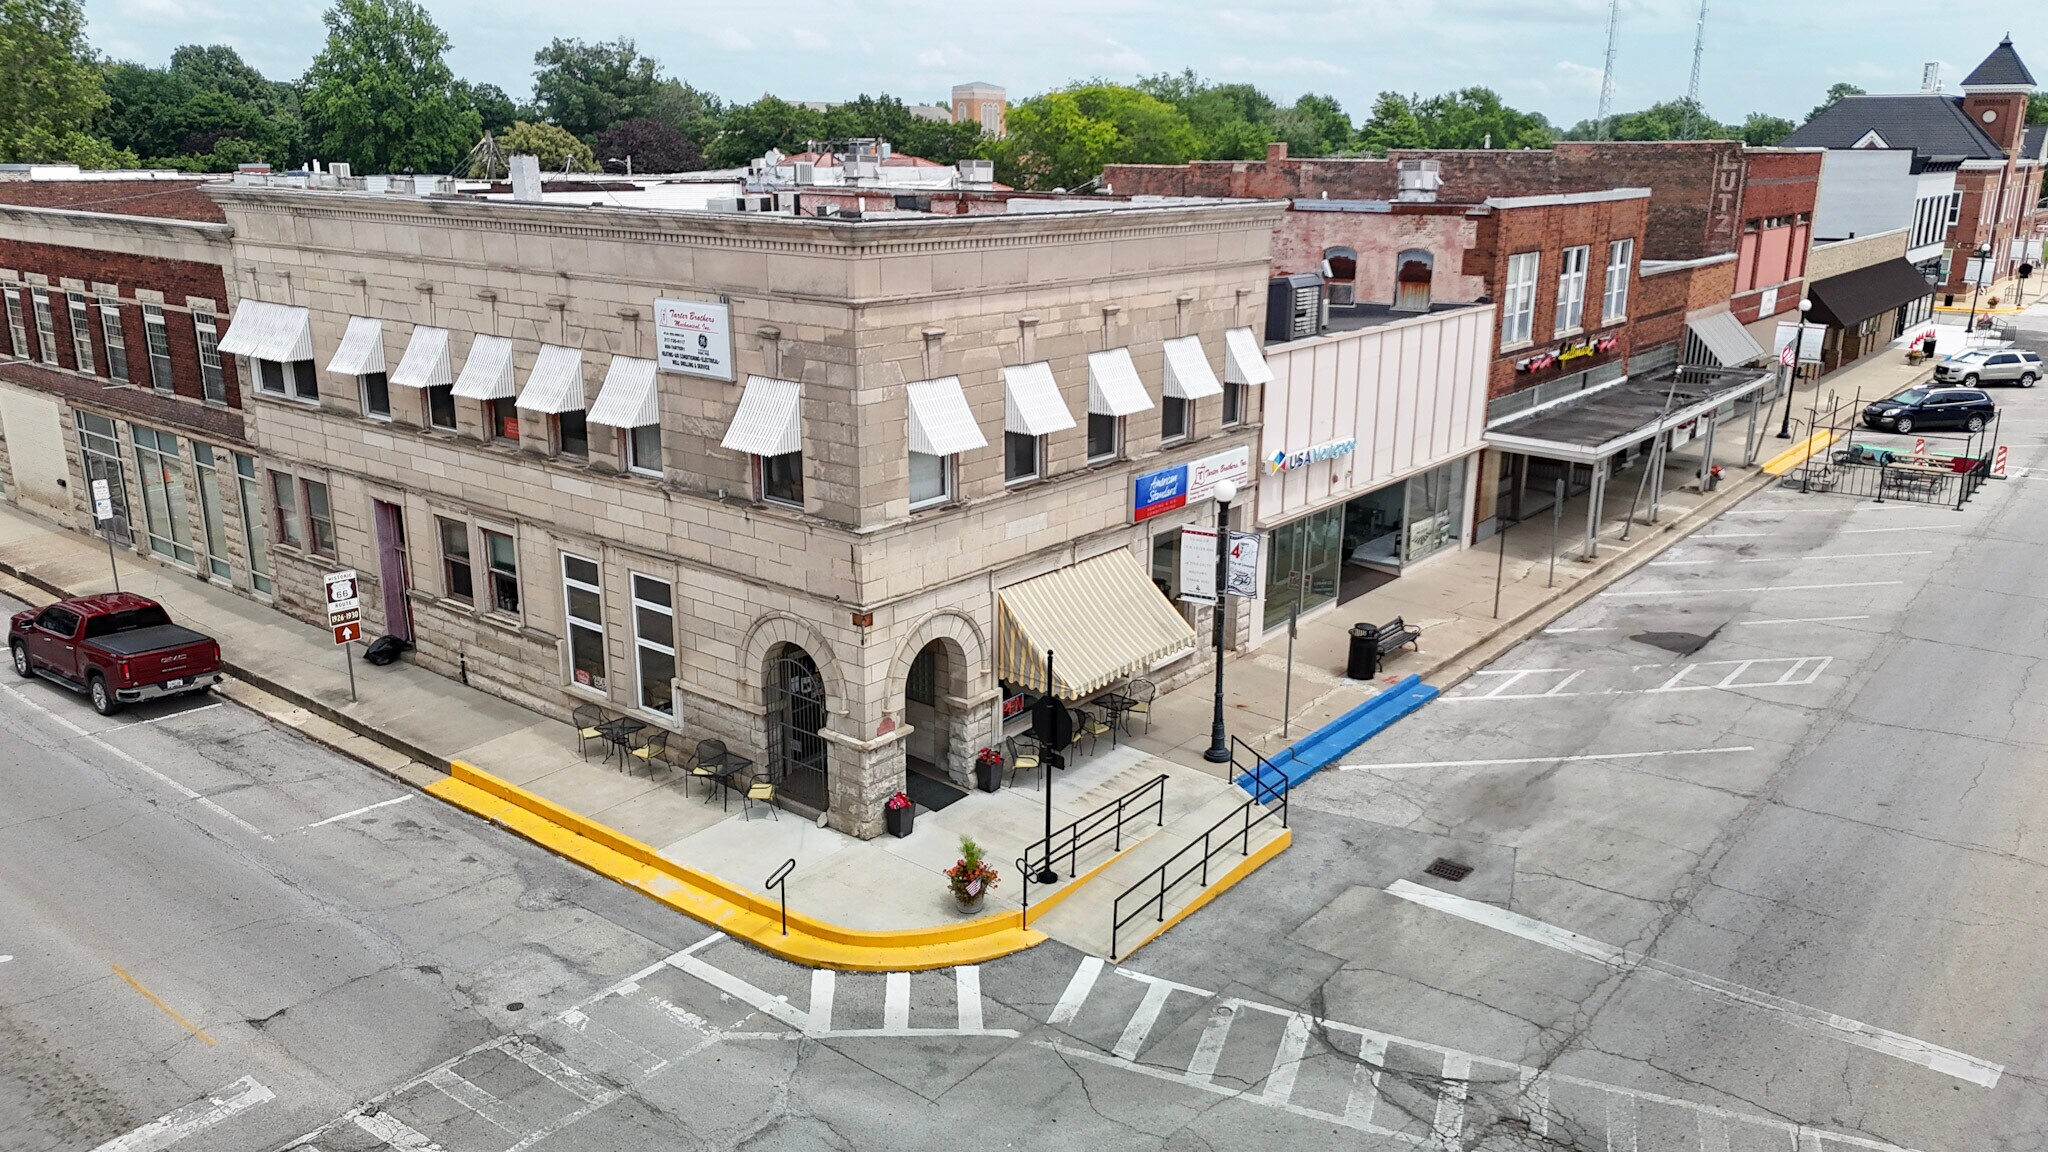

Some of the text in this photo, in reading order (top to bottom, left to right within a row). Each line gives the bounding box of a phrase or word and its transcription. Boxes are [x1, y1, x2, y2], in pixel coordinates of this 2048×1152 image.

[1713, 148, 1738, 234] LUTZ
[669, 310, 715, 322] Tarter Brothers
[1289, 450, 1311, 469] USA
[1149, 474, 1178, 490] American
[1147, 484, 1178, 504] Standard
[336, 590, 348, 598] 66
[331, 611, 358, 622] 1926-1930
[161, 654, 187, 663] GMC
